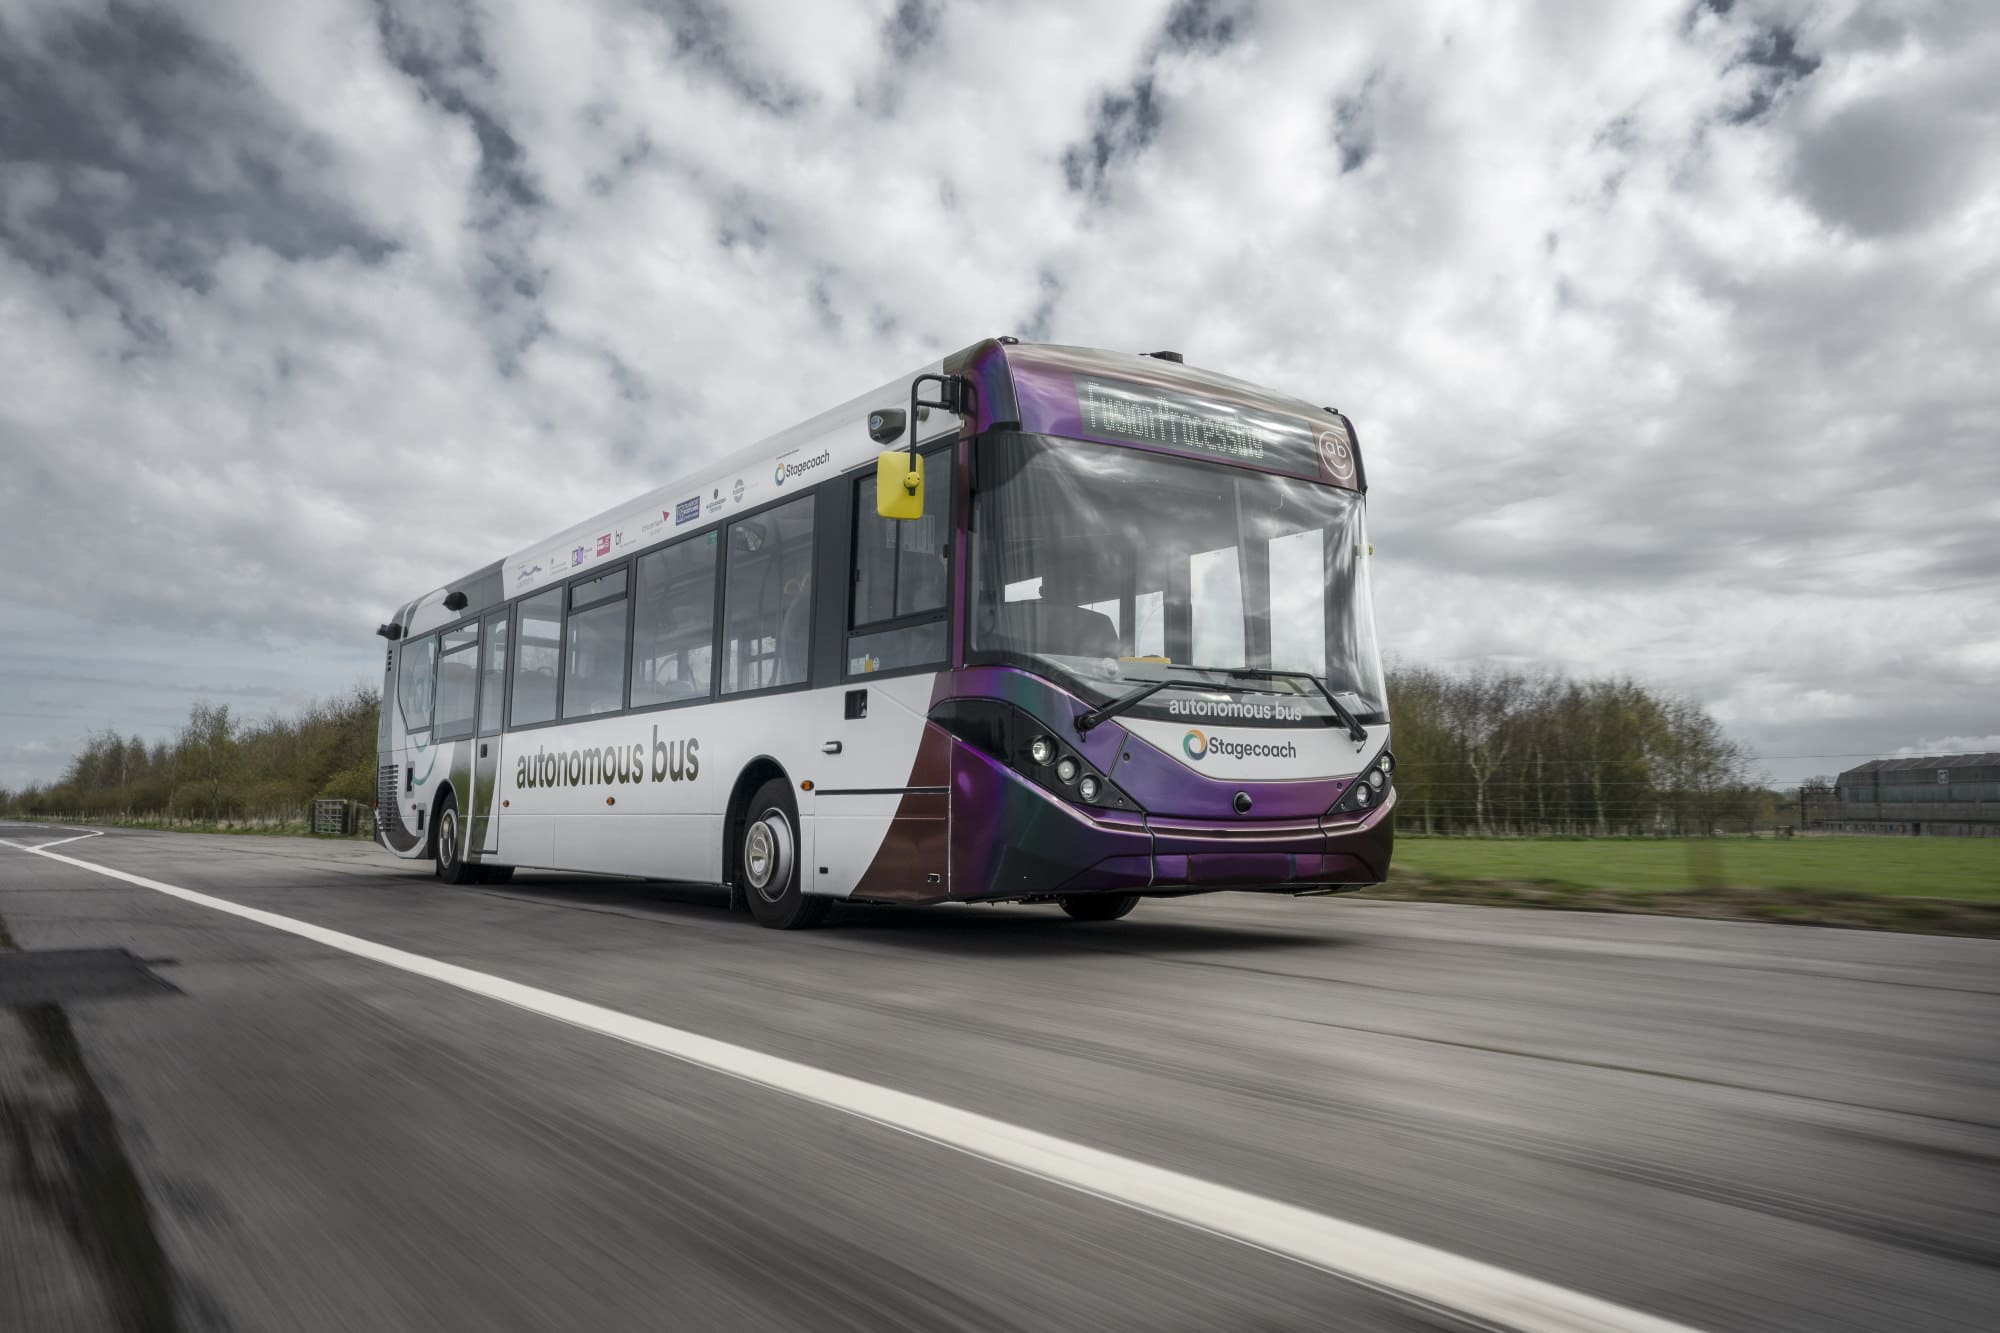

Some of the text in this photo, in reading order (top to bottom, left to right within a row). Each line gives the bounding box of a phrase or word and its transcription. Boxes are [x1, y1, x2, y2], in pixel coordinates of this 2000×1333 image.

[1325, 438, 1347, 458] ab
[785, 449, 830, 478] Stagecoach
[1169, 699, 1302, 720] autonomous bus
[516, 724, 700, 789] autonomous bus
[1209, 737, 1296, 759] Stagecoach
